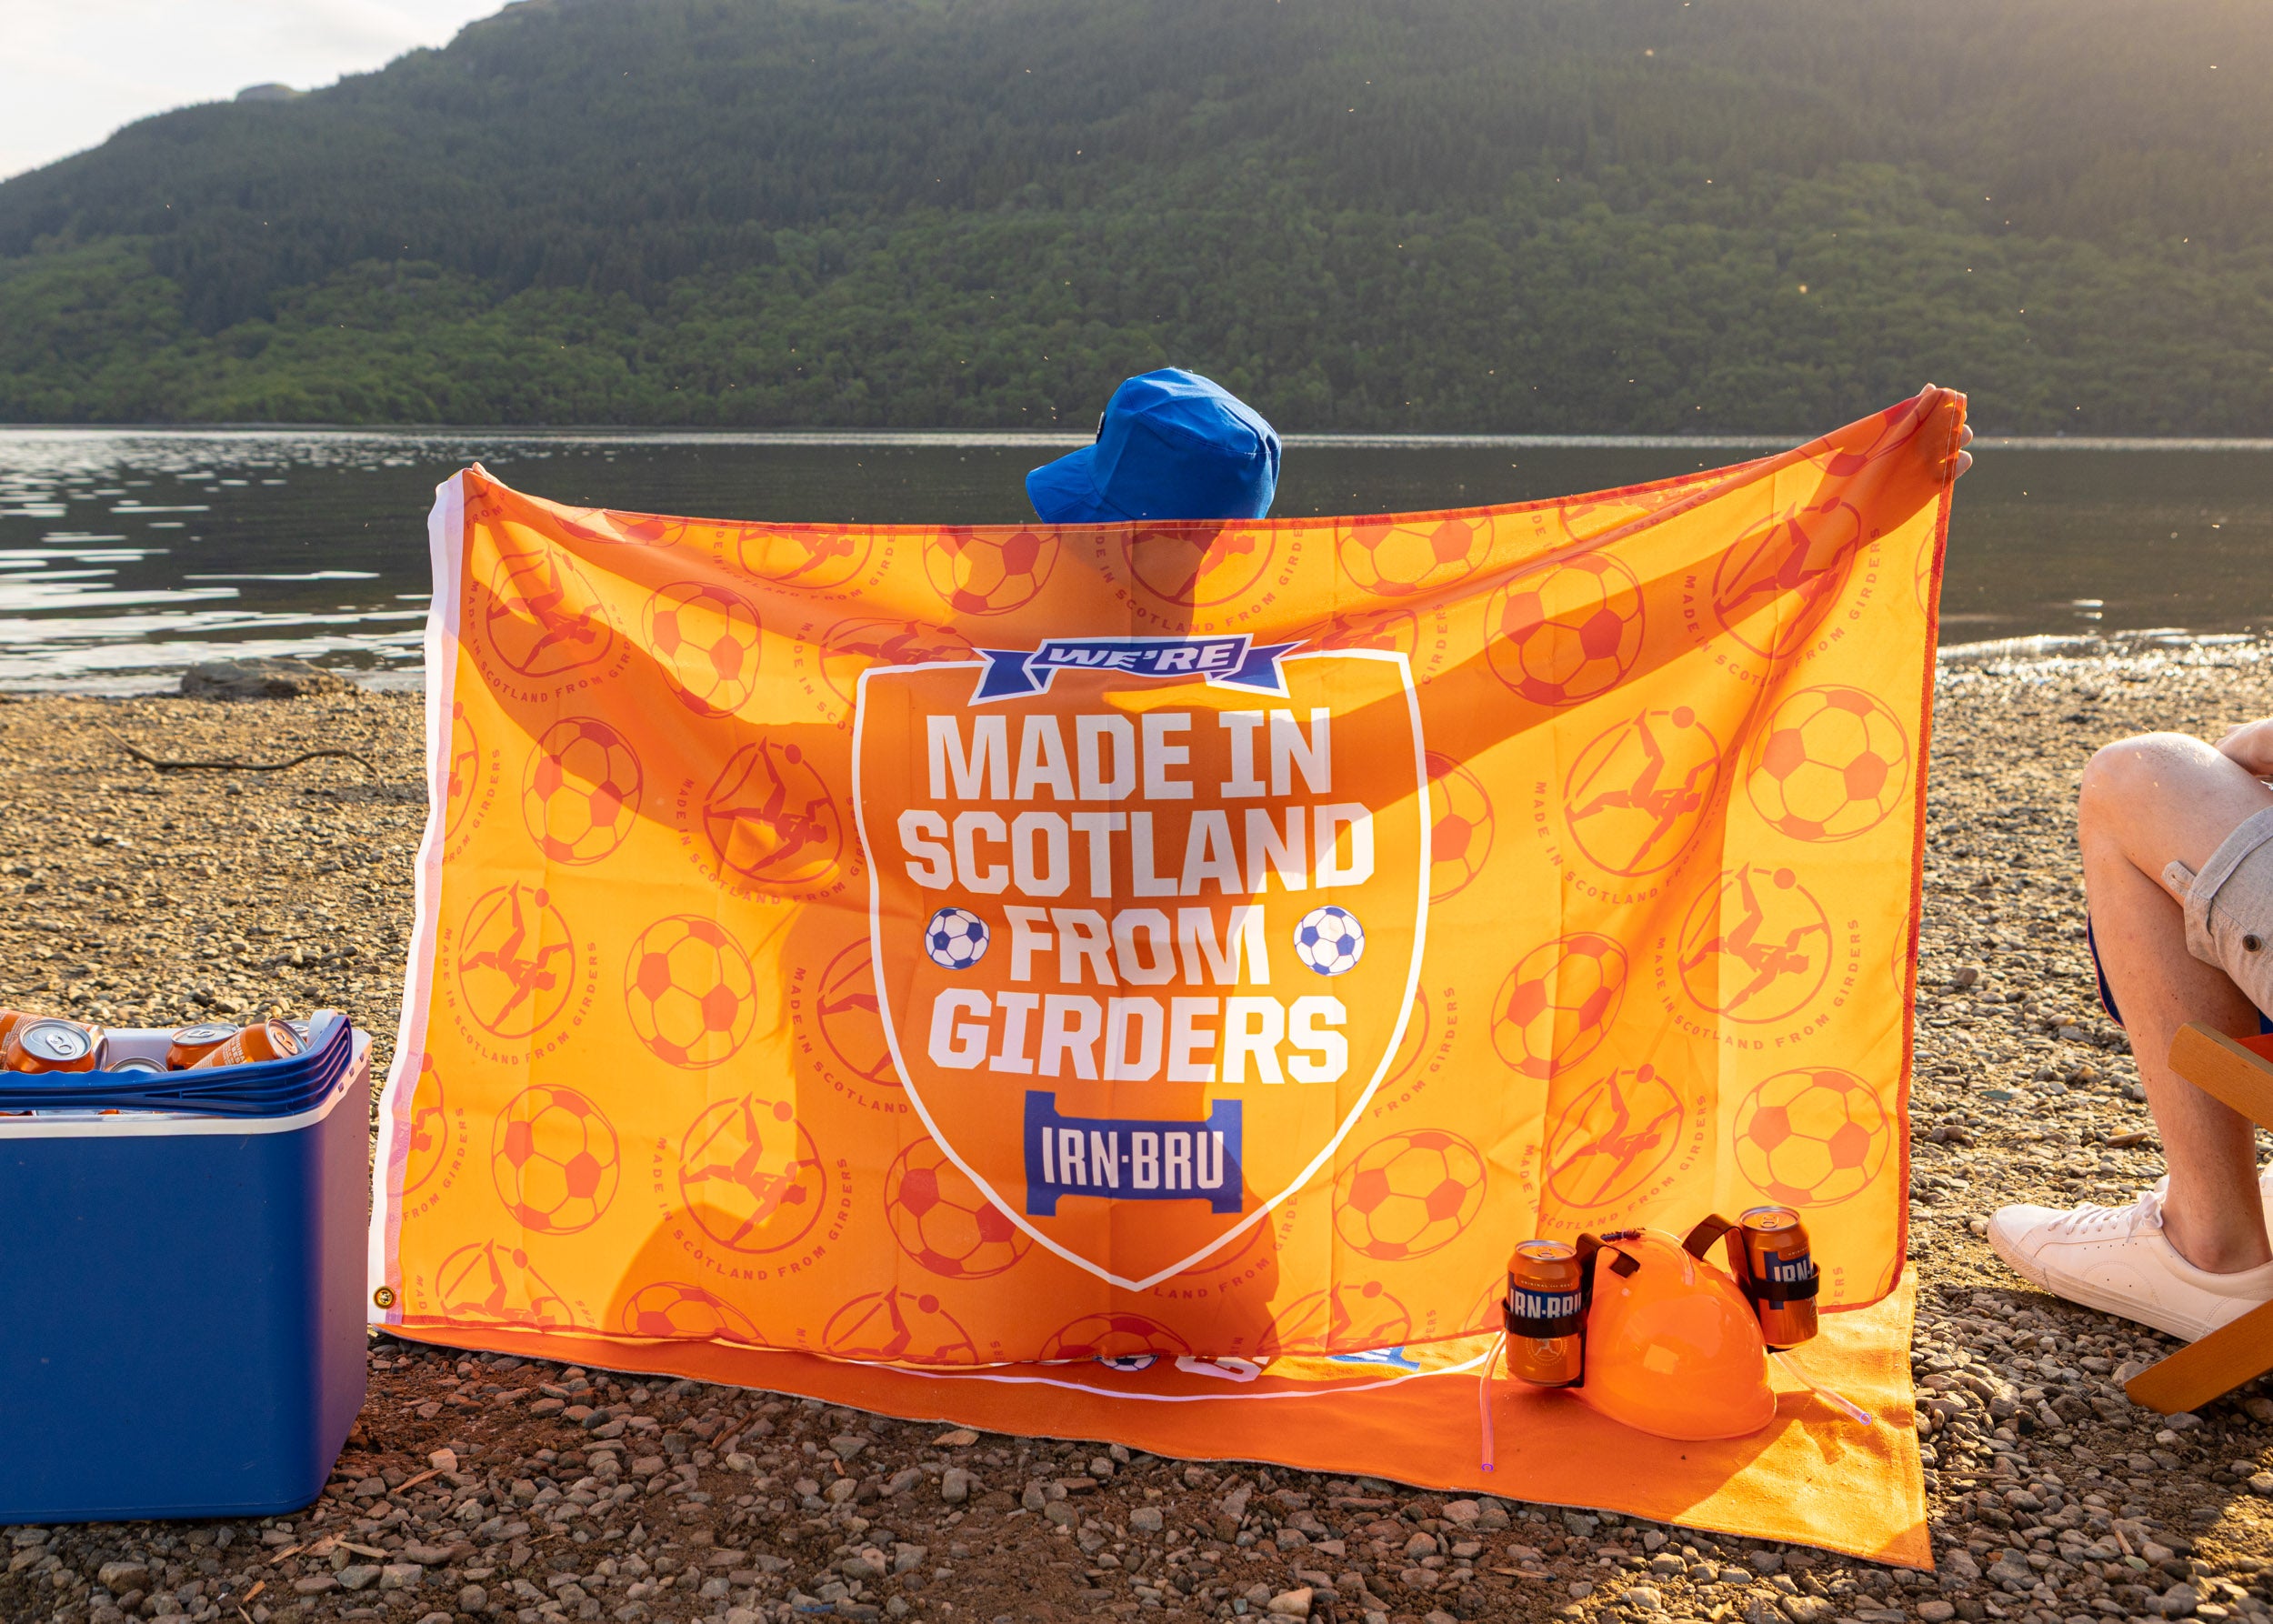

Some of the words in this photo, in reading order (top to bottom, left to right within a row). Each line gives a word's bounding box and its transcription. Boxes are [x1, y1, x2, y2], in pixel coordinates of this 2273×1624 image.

[869, 529, 896, 586] GIRDE
[1099, 565, 1116, 584] IN
[1115, 588, 1215, 633] SCOTLAND
[1225, 592, 1276, 627] FROM
[1278, 525, 1304, 586] GIRDE
[1682, 575, 1700, 634] MADE
[1695, 636, 1713, 653] IN
[1794, 627, 1845, 669] FROM
[1848, 527, 1881, 621] GIRDERS
[793, 622, 814, 668] MADE
[1047, 642, 1236, 671] WE'RE
[1421, 604, 1447, 686] GIRDERS
[480, 661, 548, 703] SCOTLAND
[555, 676, 604, 698] FROM
[798, 677, 814, 696] IN
[926, 713, 1194, 801] MADE
[1218, 707, 1332, 798] IN
[473, 748, 500, 828] GIRDERS
[676, 777, 695, 820] MADE
[678, 828, 691, 847] IN
[896, 802, 1375, 897] SCOTLAND
[1534, 781, 1549, 838] MADE
[1546, 847, 1564, 867] IN
[1565, 870, 1658, 906] SCOTLAND
[689, 853, 781, 906] SCOTLAND
[793, 880, 846, 903] FROM
[443, 927, 453, 982] MADE
[1003, 904, 1271, 986] FROM
[446, 989, 456, 1008] IN
[573, 941, 597, 1027] GIRDERS
[789, 967, 806, 1025] MADE
[1655, 937, 1667, 990] MADE
[1661, 996, 1675, 1014] IN
[1674, 1015, 1764, 1050] SCOTLAND
[1775, 1013, 1830, 1048] FROM
[1834, 918, 1861, 1007] GIRDERS
[455, 1015, 518, 1066] SCOTLAND
[526, 1030, 570, 1063] FROM
[797, 1034, 813, 1054] IN
[927, 987, 1348, 1084] GIRDERS
[1373, 1079, 1426, 1118] FROM
[1429, 987, 1457, 1074] GIRDERS
[813, 1060, 909, 1114] SCOTLAND
[403, 1194, 440, 1222] FROM
[443, 1108, 467, 1188] GIRDERS
[653, 1138, 667, 1193] MADE
[1519, 1144, 1535, 1194] MADE
[1540, 1212, 1618, 1229] SCOTLAND
[1627, 1176, 1675, 1212] FROM
[1679, 1095, 1707, 1171] GIRDERS
[659, 1202, 674, 1223] IN
[828, 1158, 853, 1241] GIRDERS
[672, 1229, 767, 1281] SCOTLAND
[777, 1246, 826, 1278] FROM
[1154, 1287, 1208, 1298] LAND
[1218, 1258, 1270, 1294] FROM
[1272, 1194, 1298, 1252] GIRDE
[416, 1274, 427, 1310] MAD
